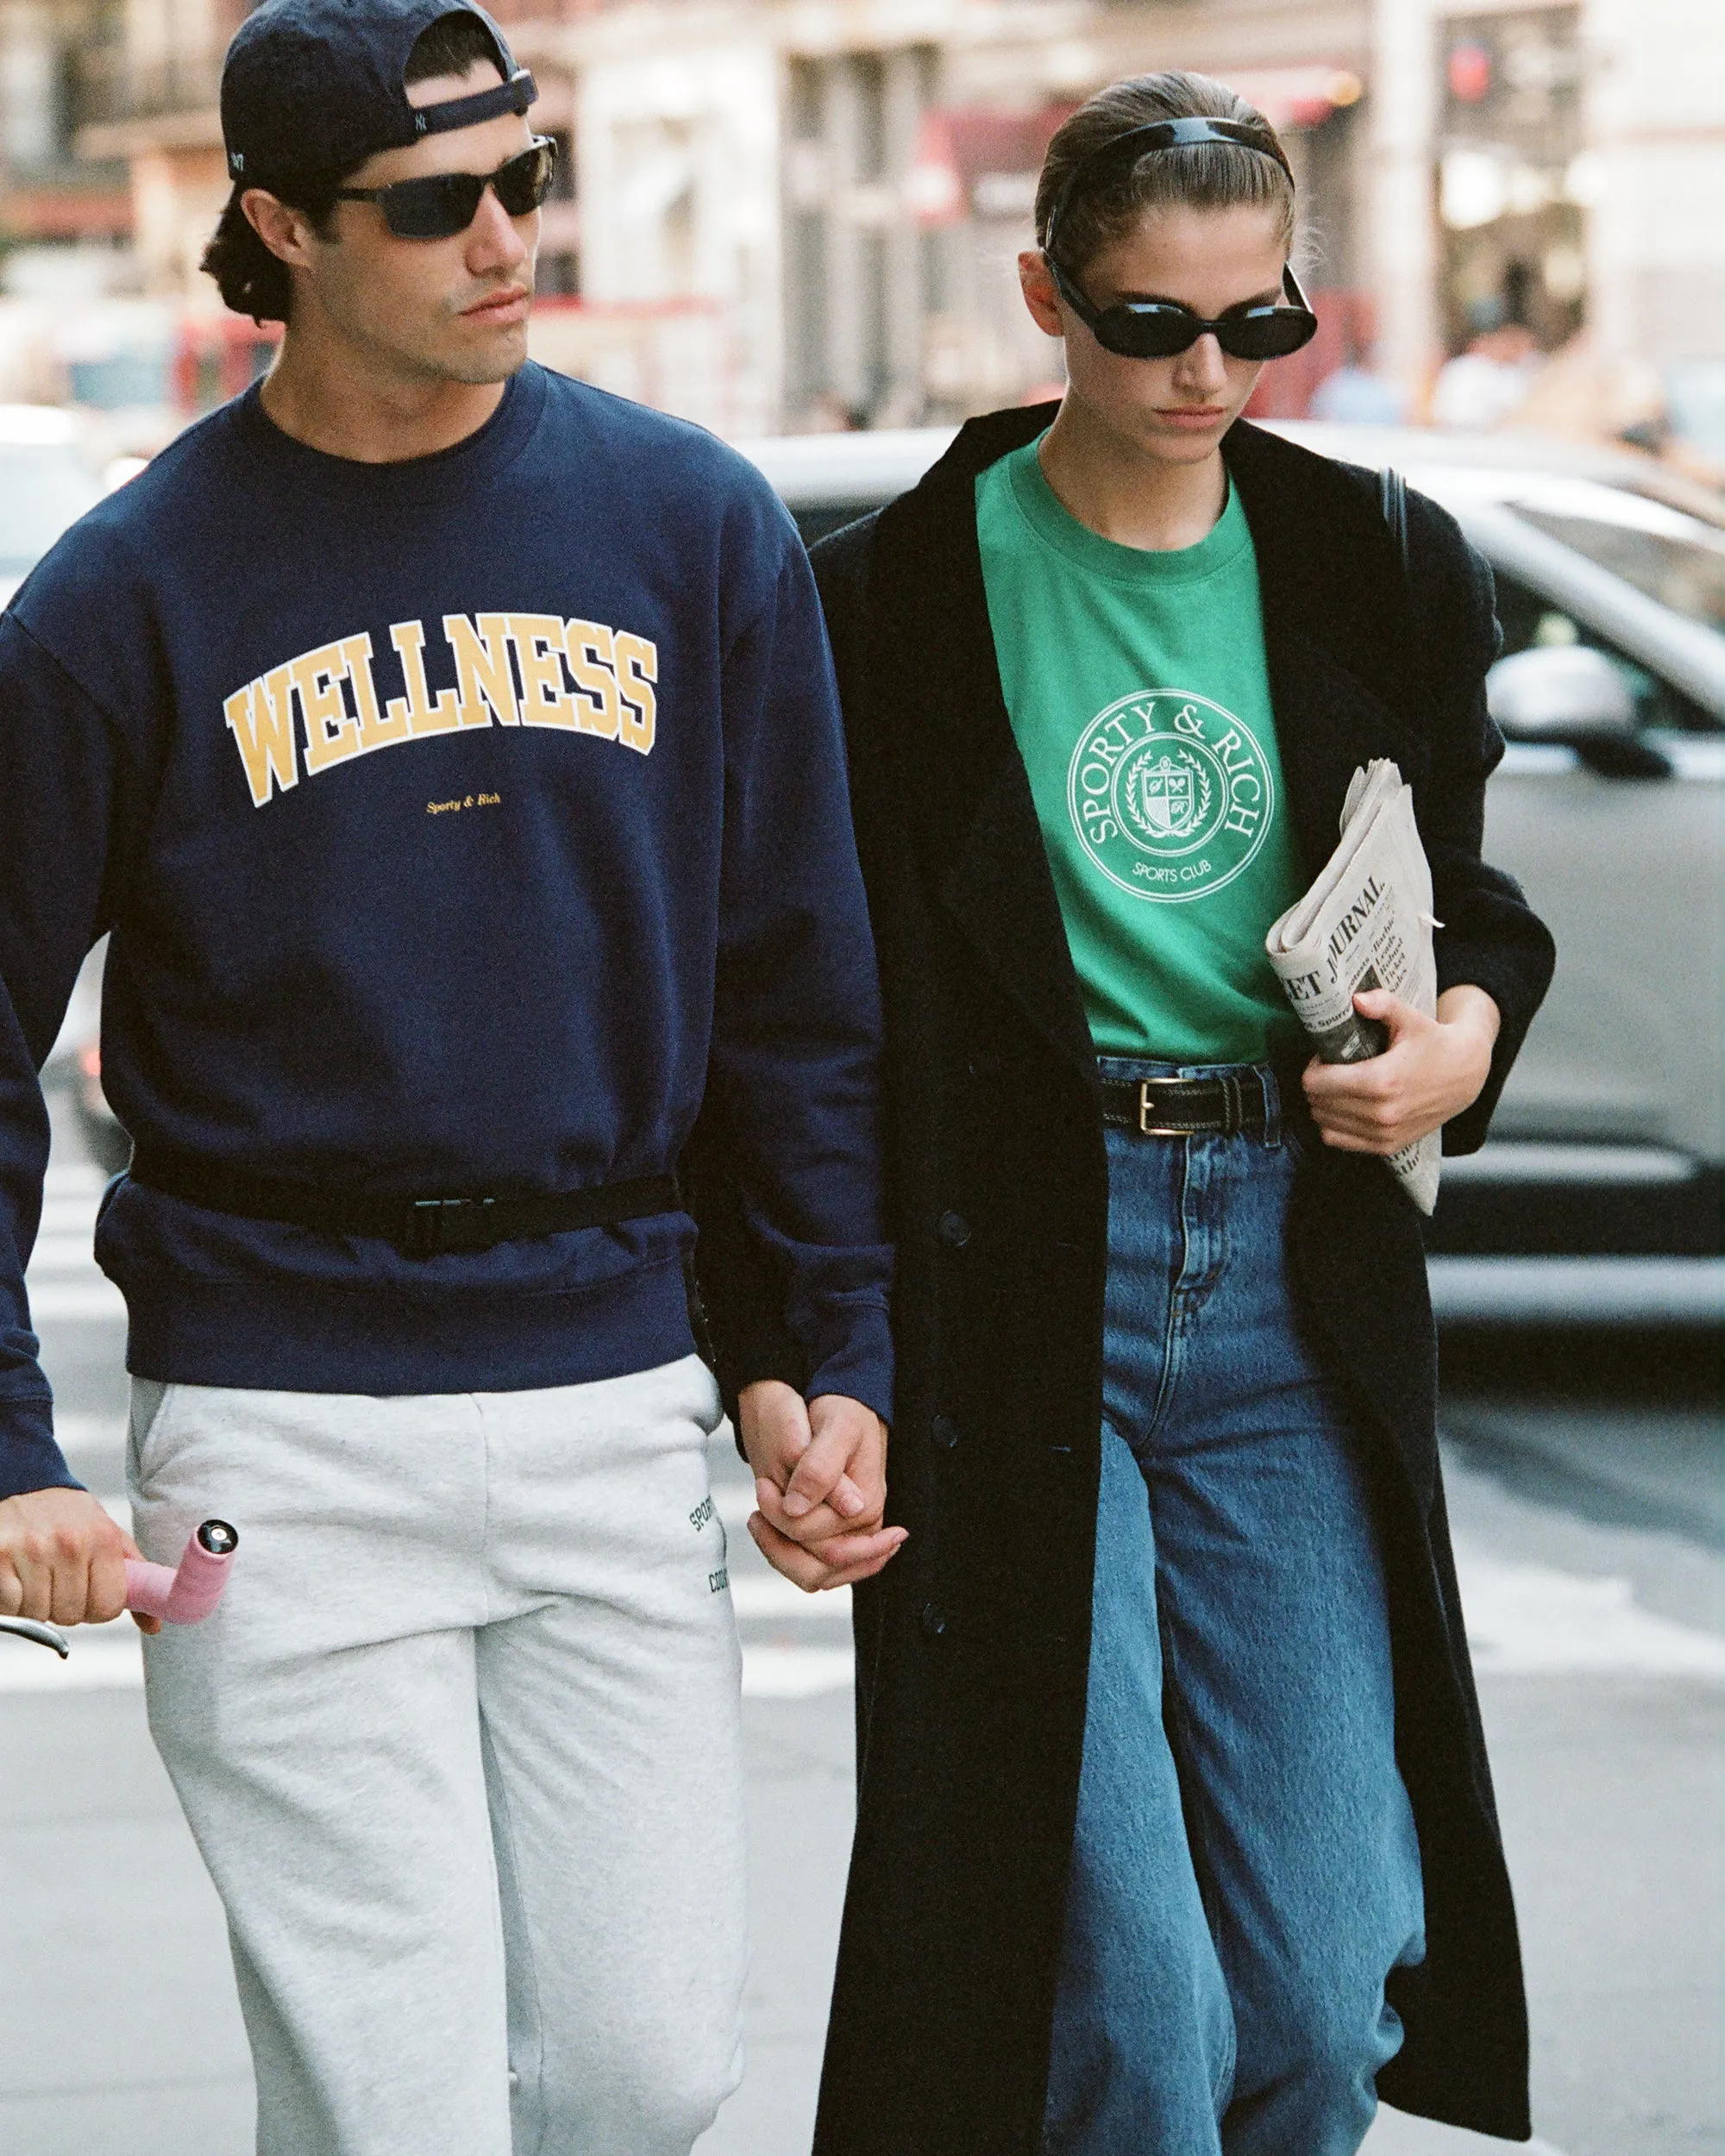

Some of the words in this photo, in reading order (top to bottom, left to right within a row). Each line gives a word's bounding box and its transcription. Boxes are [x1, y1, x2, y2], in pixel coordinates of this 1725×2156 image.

[223, 611, 658, 808] WELLNESS
[1080, 700, 1157, 845] SPORTY
[1174, 703, 1207, 740] &
[1211, 727, 1261, 839] RICH
[426, 799, 462, 815] Sporty
[463, 794, 475, 808] &
[476, 792, 502, 807] Rich
[1132, 861, 1178, 883] SPORTS
[1179, 859, 1212, 881] CLUB
[1281, 969, 1322, 1000] ET
